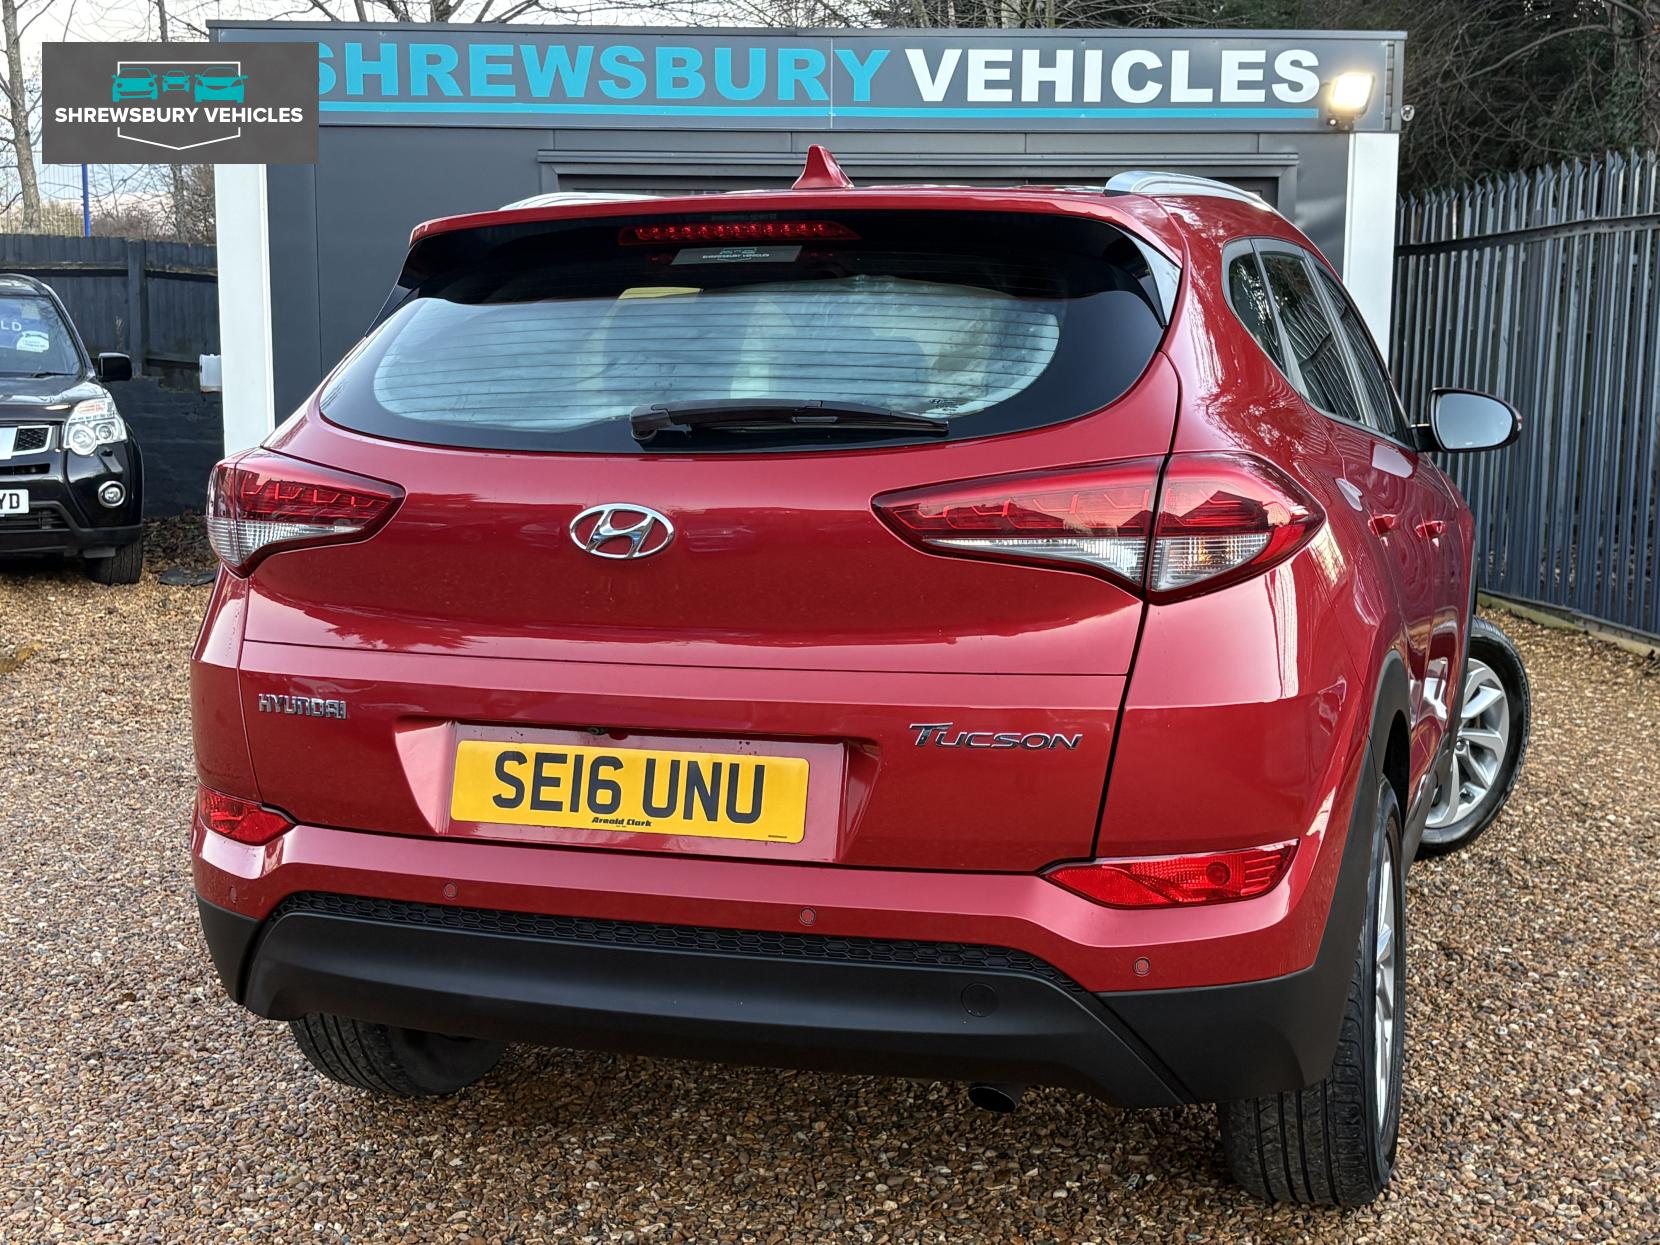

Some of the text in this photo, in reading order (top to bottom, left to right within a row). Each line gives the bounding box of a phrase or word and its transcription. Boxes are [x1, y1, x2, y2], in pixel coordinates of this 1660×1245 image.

[905, 49, 1320, 104] VEHICLES
[258, 693, 347, 719] HYUNDAI
[909, 722, 1083, 750] TUCSON
[492, 751, 765, 824] SE16 UNU
[592, 816, 652, 827] Arnold Clark
